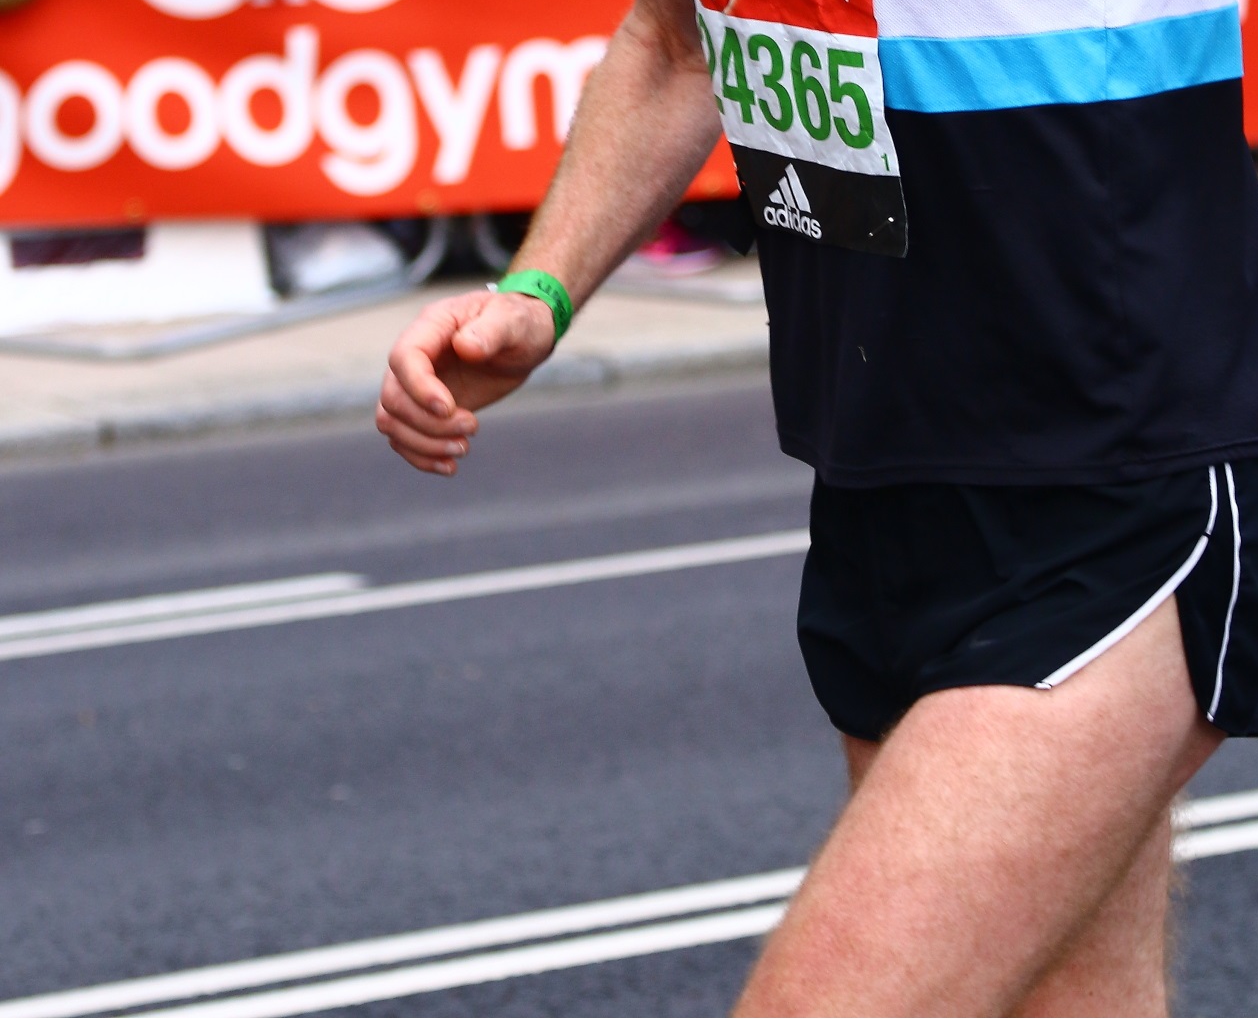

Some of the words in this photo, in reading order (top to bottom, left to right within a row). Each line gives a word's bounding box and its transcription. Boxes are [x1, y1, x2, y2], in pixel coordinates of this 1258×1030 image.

[0, 24, 610, 195] oodgym
[881, 153, 890, 171] 1
[764, 205, 822, 240] adidas
